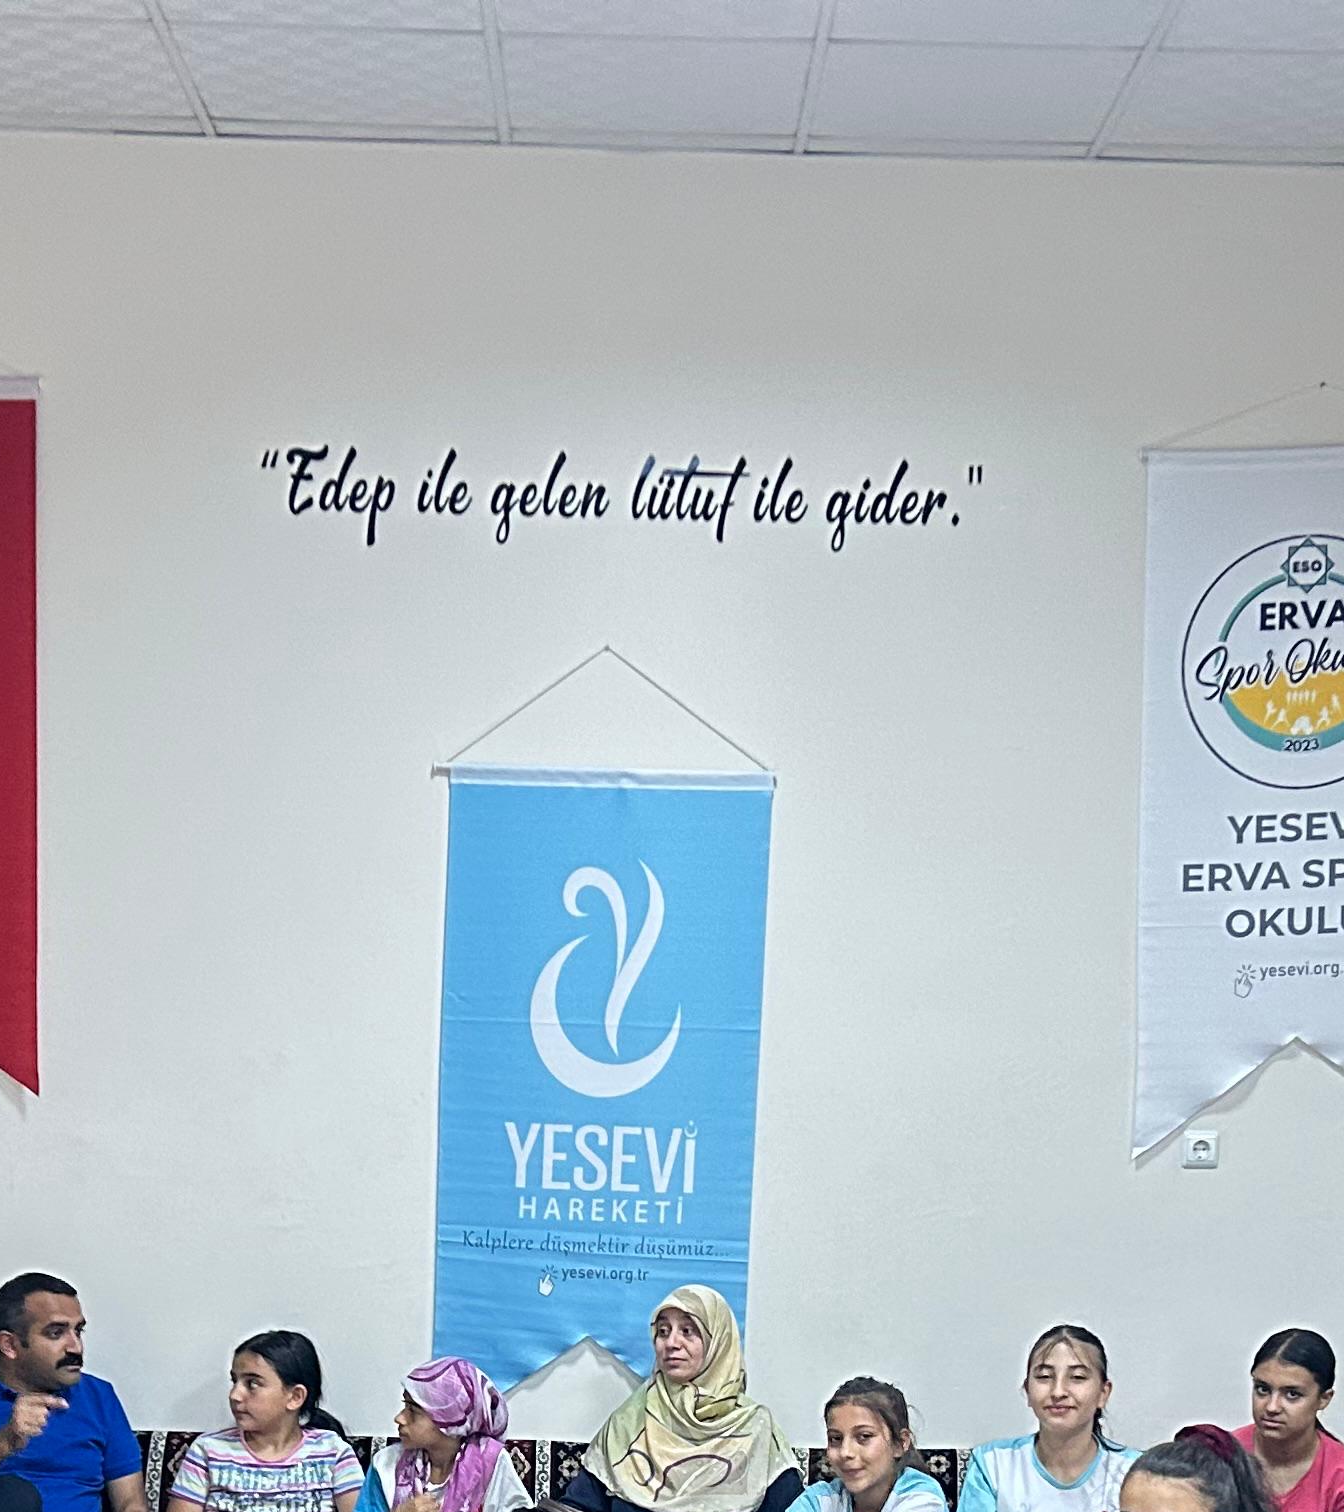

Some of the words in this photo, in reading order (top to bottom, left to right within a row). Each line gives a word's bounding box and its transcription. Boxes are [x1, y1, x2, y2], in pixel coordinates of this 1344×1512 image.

[417, 448, 472, 517] ile
[490, 450, 609, 544] gelen
[753, 458, 808, 523] ile
[1292, 560, 1322, 573] ESO
[1195, 645, 1281, 703] Spor
[1284, 738, 1320, 752] 2023
[1182, 861, 1290, 892] ERVA
[504, 1120, 698, 1194] YESEVİ
[518, 1196, 684, 1224] HAREKETİ
[462, 1230, 534, 1251] Kalplere
[539, 1231, 631, 1255] düşmektir
[561, 1265, 649, 1284] yesevi.org.tr
